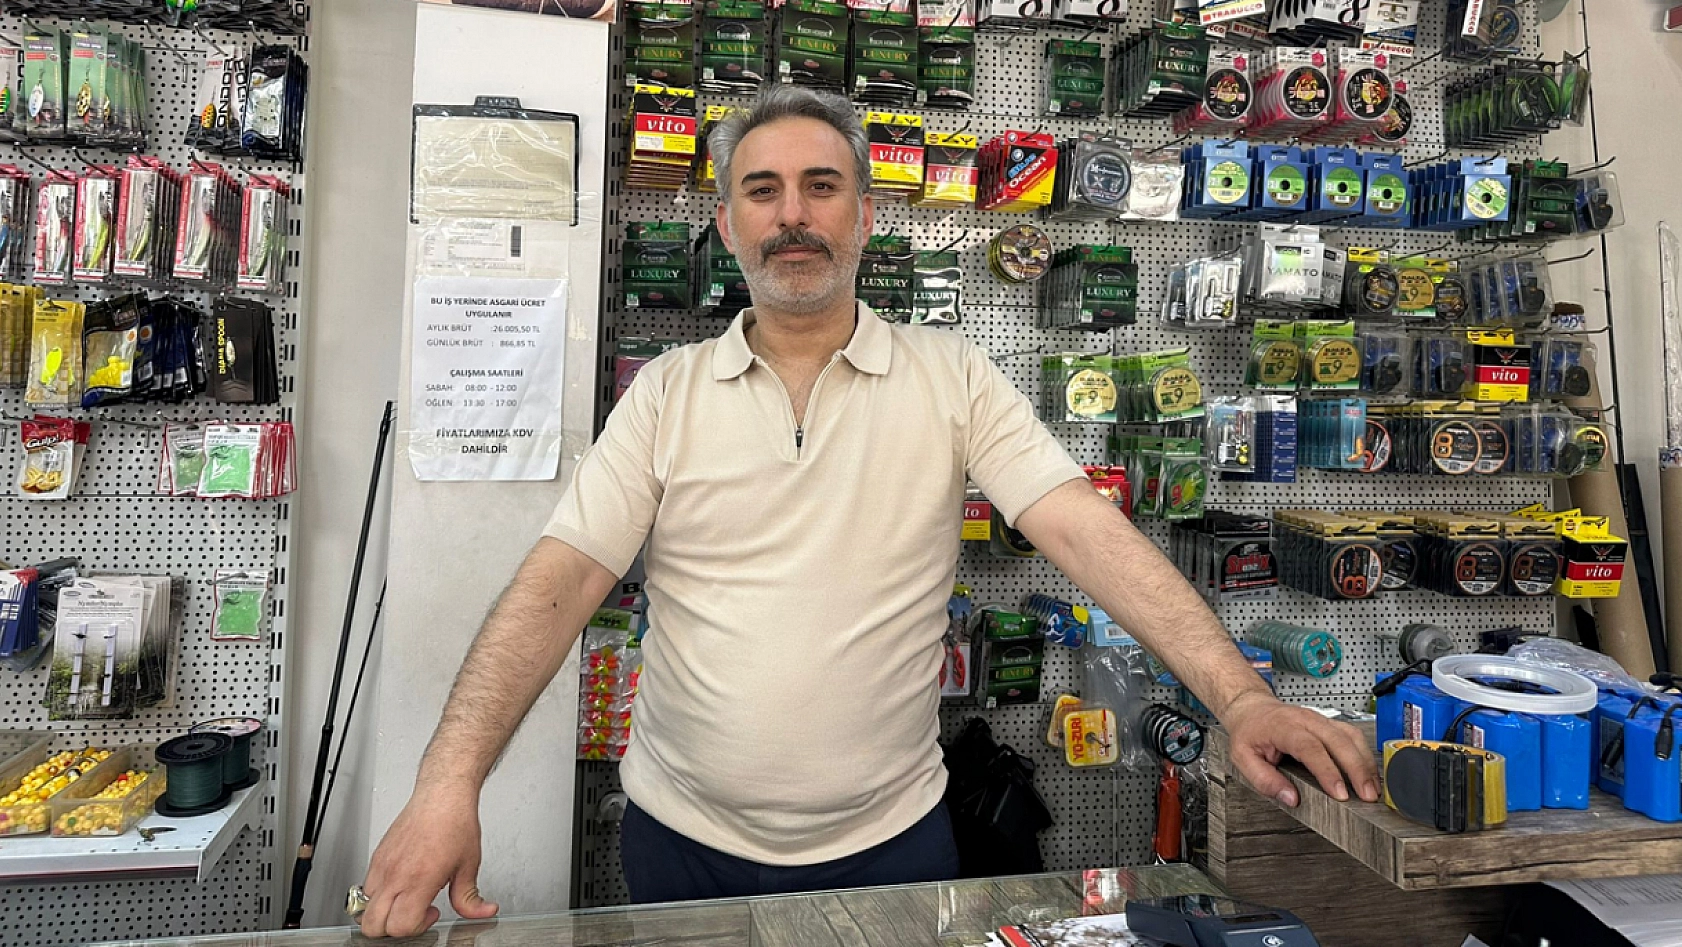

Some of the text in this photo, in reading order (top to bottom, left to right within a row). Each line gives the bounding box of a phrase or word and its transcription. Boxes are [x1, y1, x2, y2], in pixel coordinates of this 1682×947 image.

[1212, 3, 1262, 18] TRABUCCO
[709, 43, 757, 53] LUXURY
[789, 36, 838, 52] LUXURY
[634, 48, 685, 59] LUXURY
[862, 49, 910, 61] LUXURY
[1158, 60, 1202, 73] LUXURY
[923, 68, 968, 77] LUXURY
[1057, 79, 1099, 90] LUXURY
[647, 117, 686, 132] vito
[879, 147, 914, 163] vito
[935, 168, 969, 183] vito
[631, 270, 680, 278] LUXURY
[1268, 266, 1318, 277] YAMATO
[861, 277, 908, 288] LUXURY
[1086, 287, 1131, 297] LUXURY
[444, 297, 452, 306] İŞ
[454, 297, 488, 305] YERİNDE
[489, 297, 519, 306] ASGARİ
[520, 298, 546, 306] ÜCRET
[465, 310, 512, 318] UYGULANIR
[427, 324, 449, 332] AYLIK
[451, 323, 472, 332] BRÜT
[427, 339, 460, 347] GÜNLÜK
[462, 339, 483, 347] BRÜT
[450, 368, 523, 377] ÇALIŞMA SAATLERİ
[1333, 360, 1342, 374] 9
[1491, 368, 1519, 382] vito
[1174, 388, 1184, 403] 9
[436, 427, 534, 438] FİYATLARIMIZA KDV
[461, 442, 508, 453] DAHİLDİR
[964, 505, 980, 518] to
[1586, 565, 1613, 578] vito
[995, 668, 1035, 679] LUXURY
[1071, 717, 1084, 761] YO-ZURI
